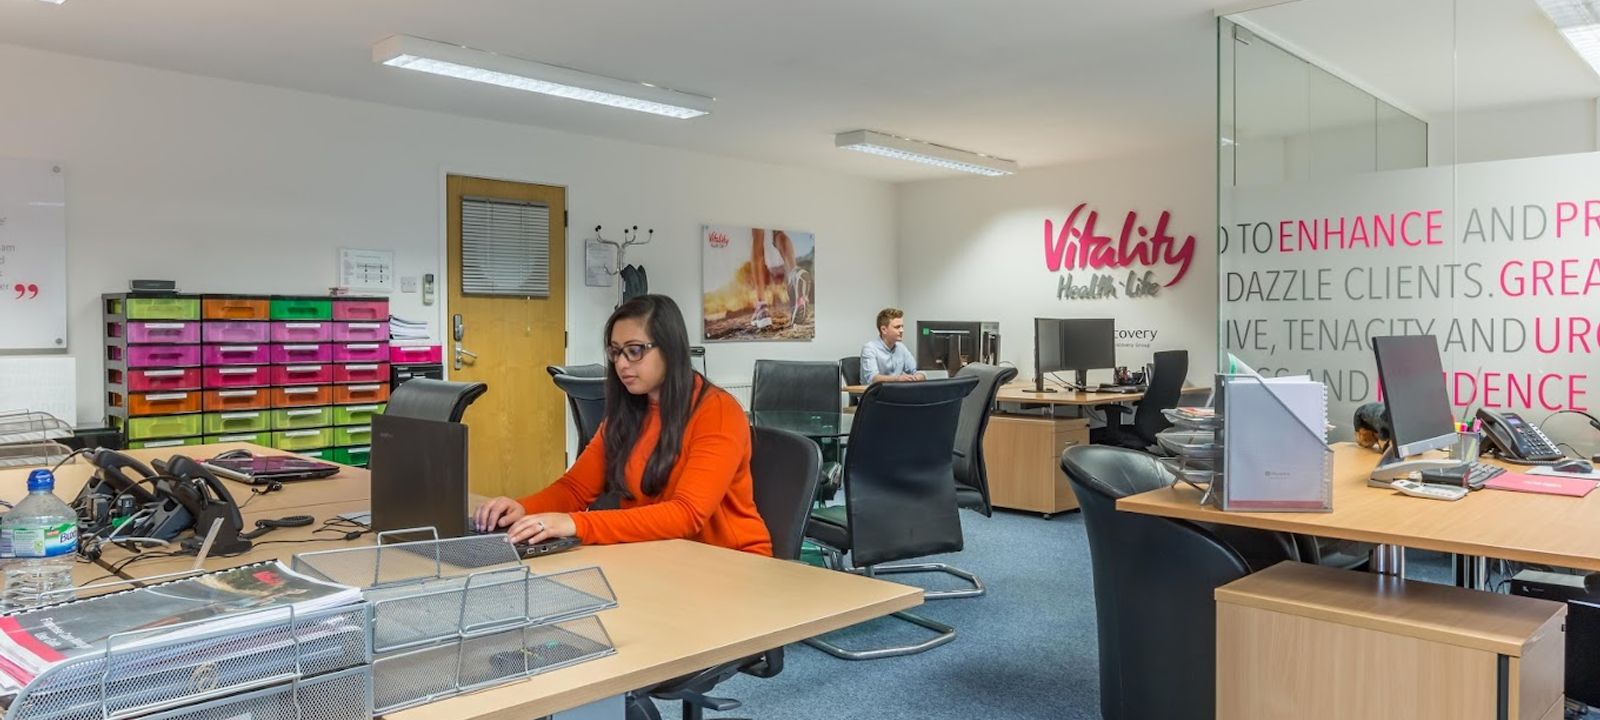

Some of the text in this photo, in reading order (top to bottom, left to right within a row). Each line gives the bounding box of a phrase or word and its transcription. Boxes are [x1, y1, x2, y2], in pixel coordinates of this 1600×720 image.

[1044, 202, 1196, 288] Vitality
[1237, 221, 1274, 254] TO
[1278, 210, 1444, 252] ENHANCE
[1462, 204, 1548, 244] AND
[1056, 273, 1119, 300] Health
[1226, 269, 1332, 302] DAZZLE
[1344, 262, 1494, 300] CLIENTS.
[1444, 318, 1527, 352] AND
[1534, 317, 1600, 353] UR
[1304, 367, 1370, 402] ND
